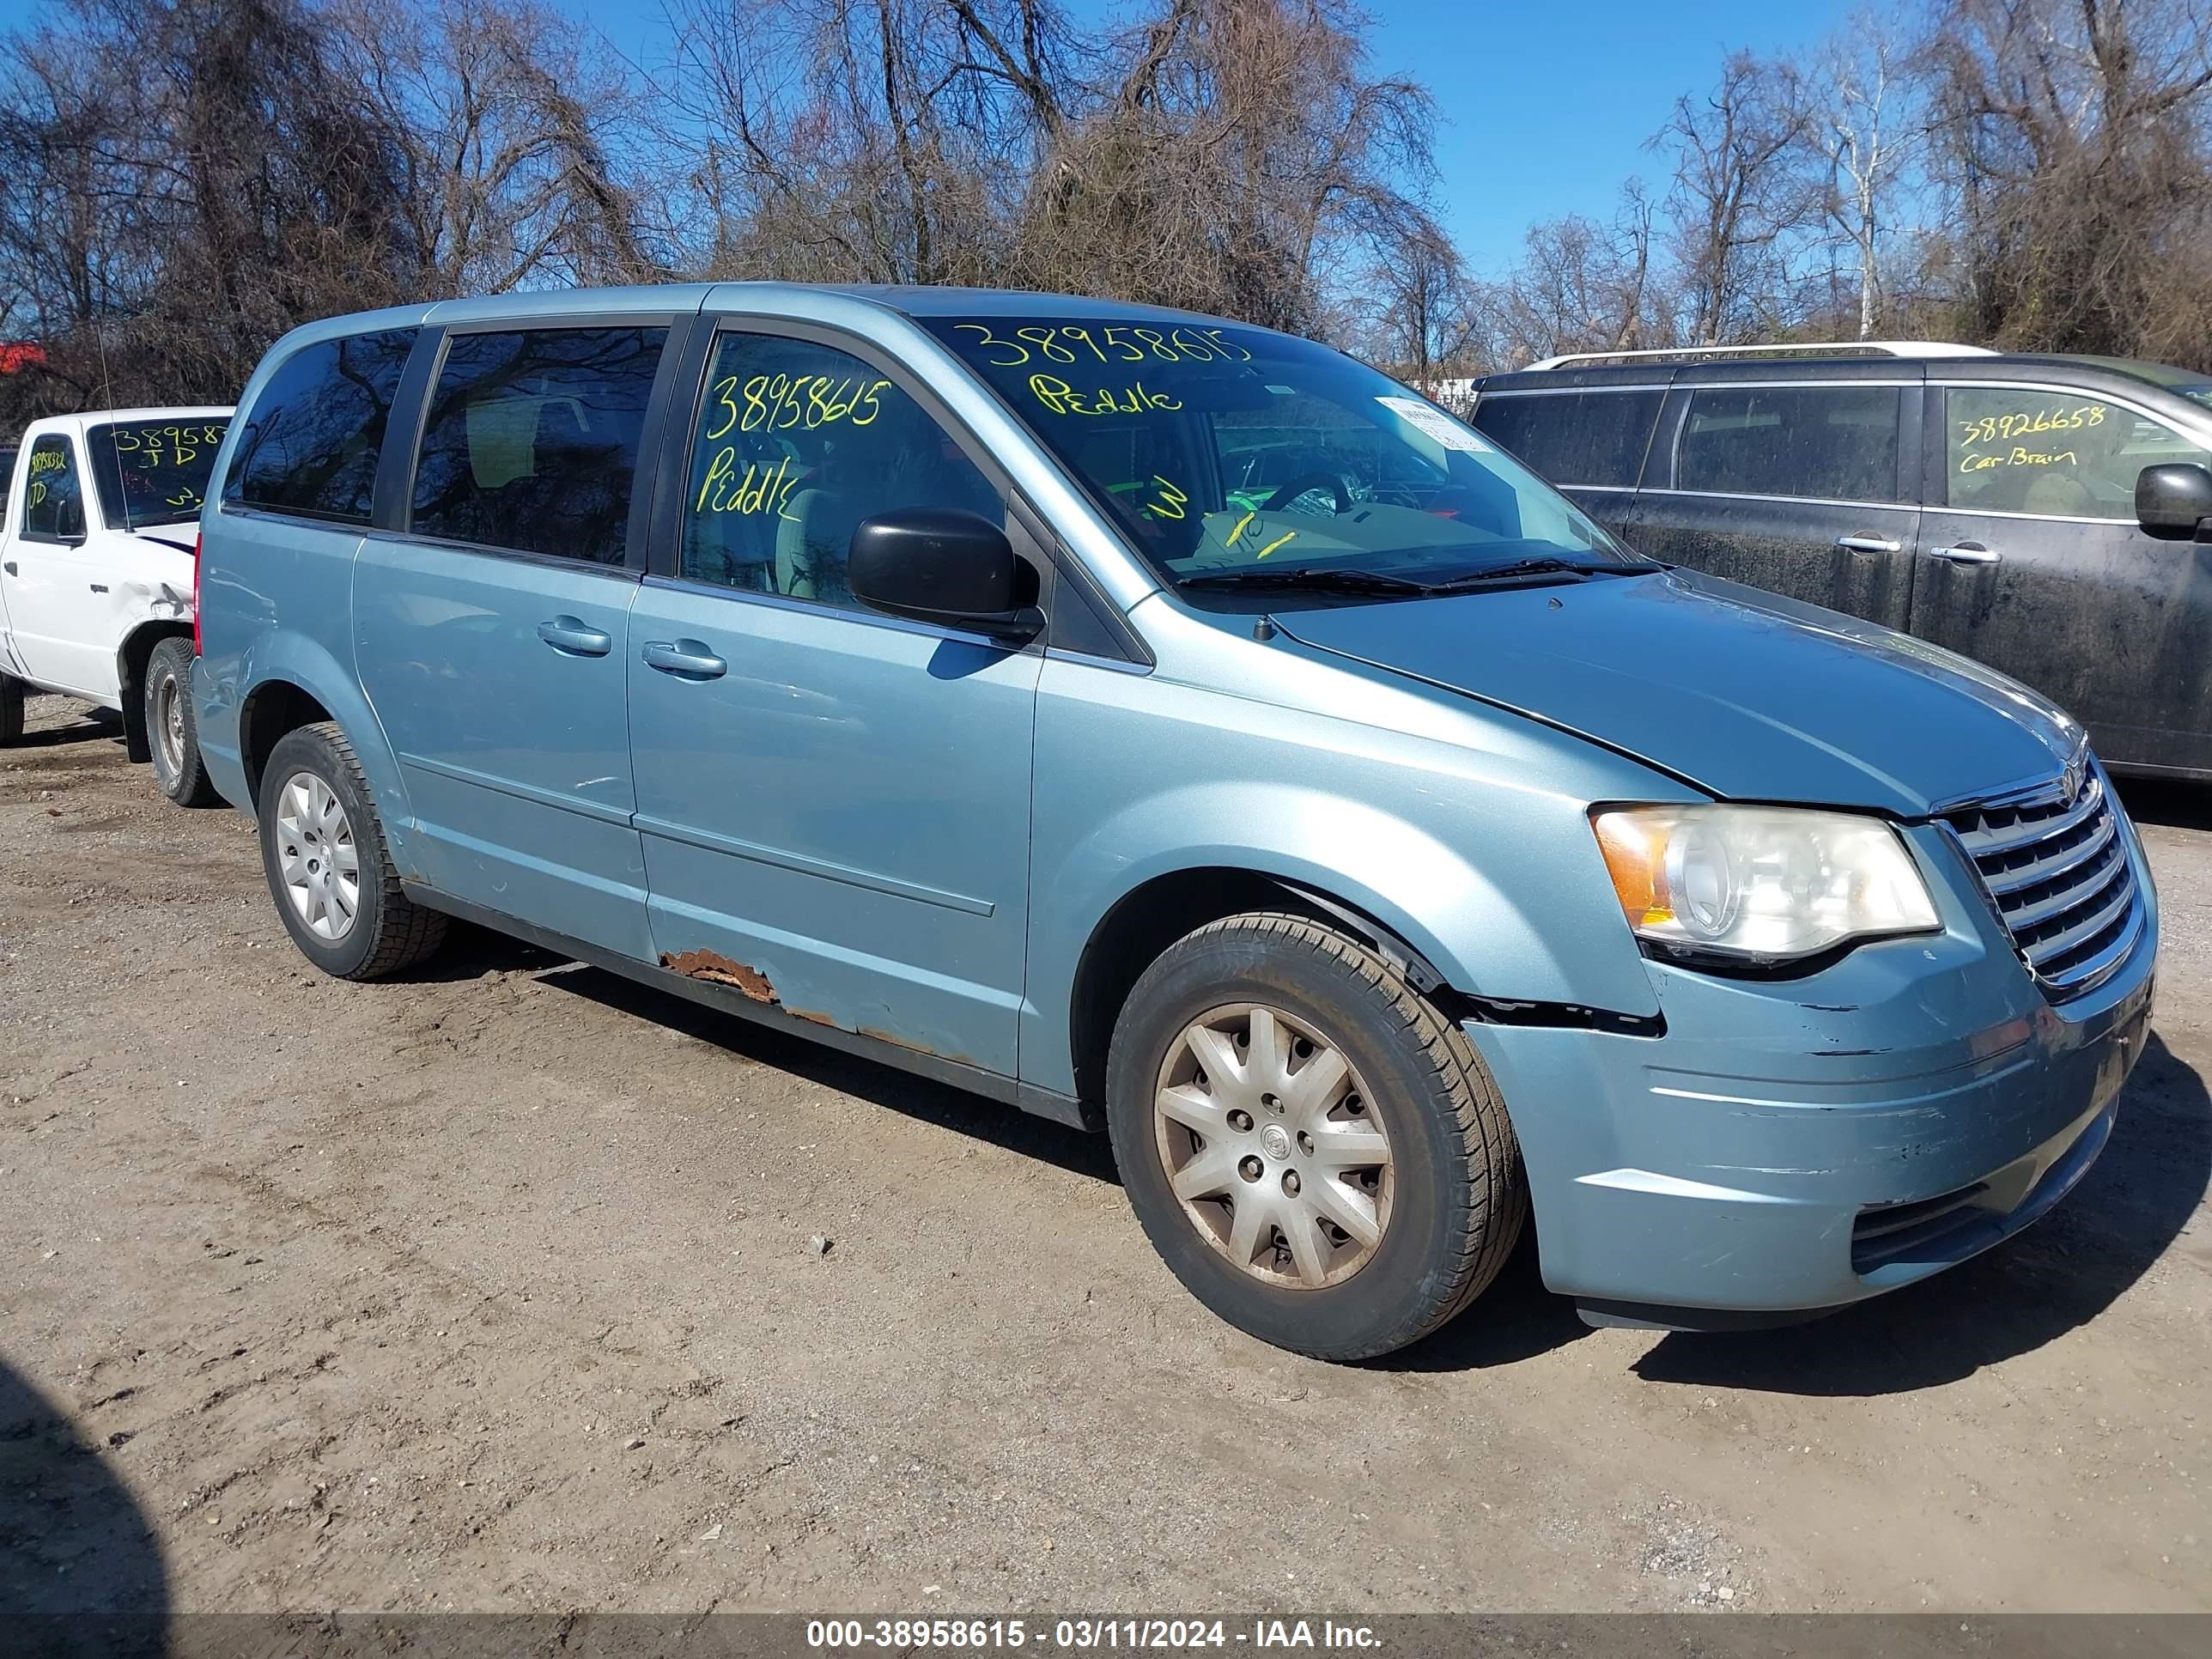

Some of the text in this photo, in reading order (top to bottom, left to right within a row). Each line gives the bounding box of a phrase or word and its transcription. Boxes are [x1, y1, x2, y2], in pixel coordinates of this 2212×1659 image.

[953, 325, 1251, 365] 38958615
[707, 373, 892, 440] 38958615
[1958, 406, 2106, 447] 38926658
